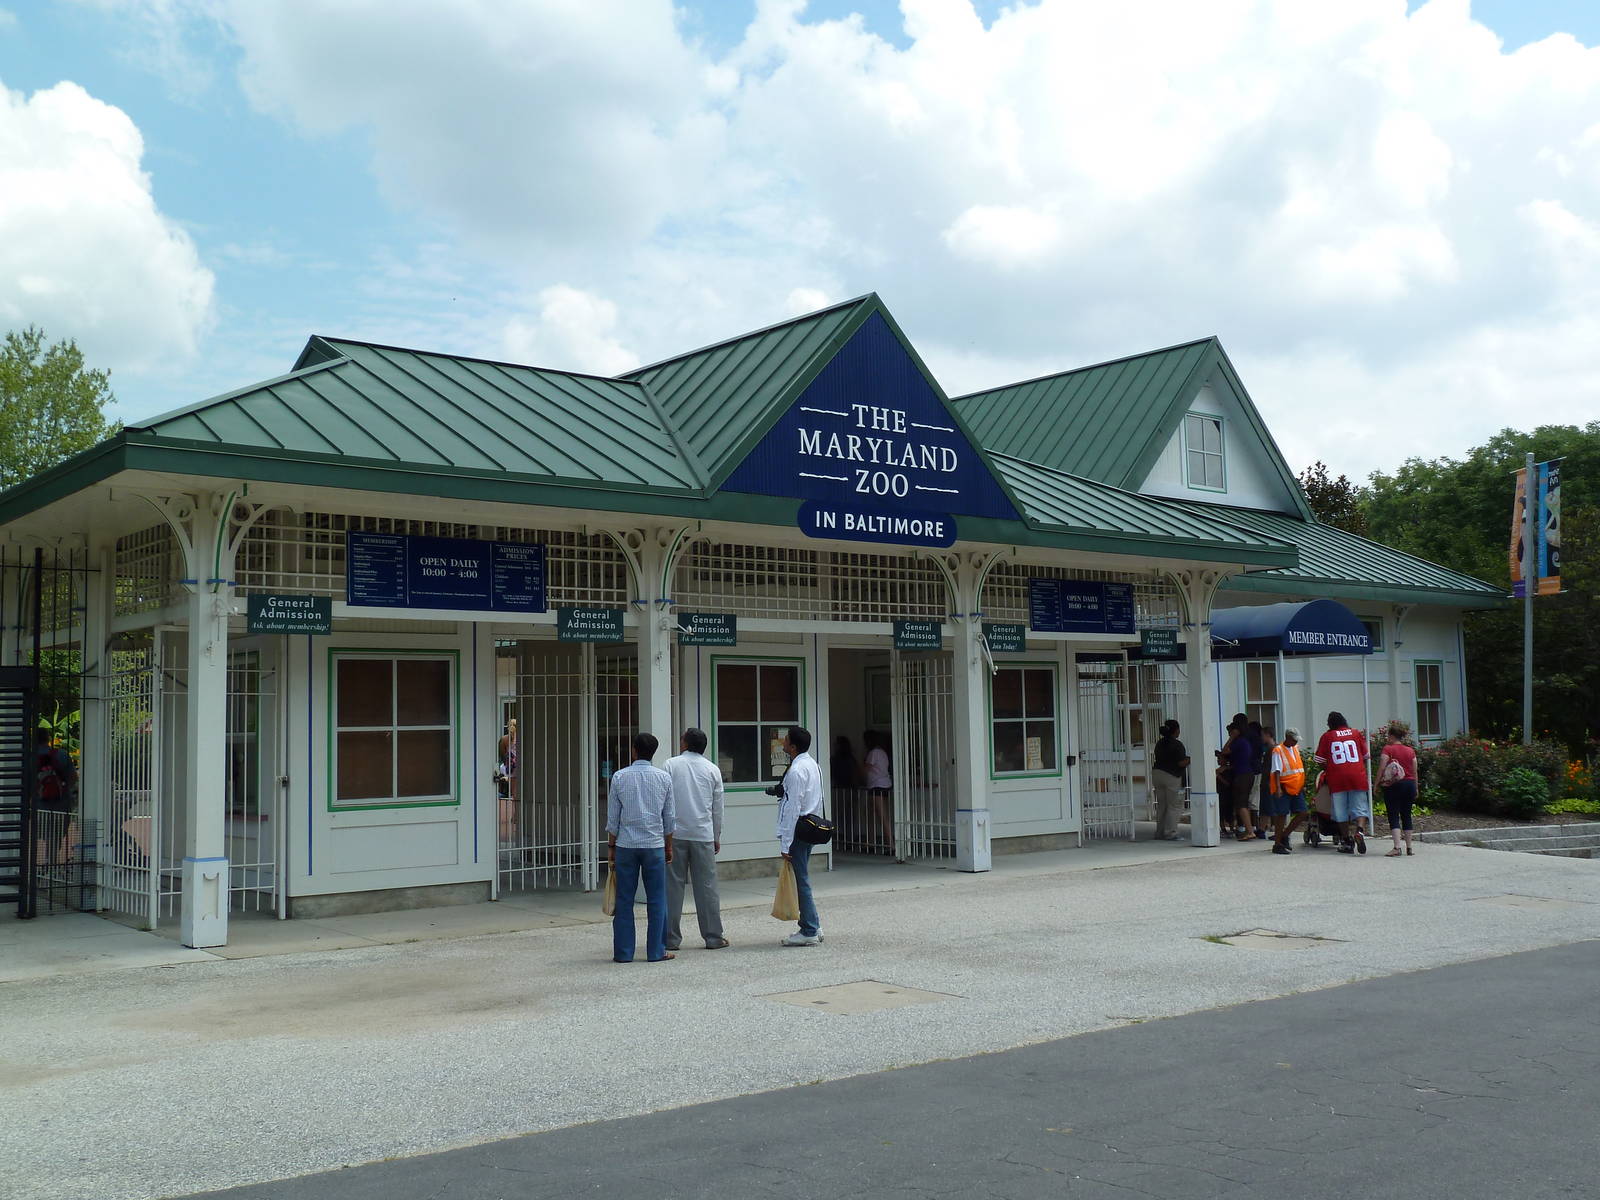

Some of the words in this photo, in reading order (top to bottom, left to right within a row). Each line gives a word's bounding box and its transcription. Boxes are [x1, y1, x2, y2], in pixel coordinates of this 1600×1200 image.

[852, 404, 907, 434] THE
[798, 428, 958, 472] MARYLAND
[855, 469, 909, 498] ZOO
[816, 510, 836, 529] IN
[845, 513, 944, 538] BALTIMORE
[420, 557, 447, 566] OPEN
[450, 559, 480, 568] DAILY
[422, 568, 446, 576] 10:00
[458, 570, 478, 578] 4:00
[268, 597, 314, 608] General
[260, 608, 321, 619] Admission
[573, 609, 610, 620] General
[567, 619, 616, 630] Admission
[692, 615, 724, 624] General
[905, 623, 932, 631] General
[992, 625, 1017, 633] General
[589, 632, 623, 640] membership!
[900, 630, 936, 640] Admission
[988, 633, 1021, 641] Admission
[1289, 631, 1325, 645] MEMBER
[1327, 633, 1368, 647] ENTRANCE
[1336, 729, 1352, 737] RICE
[1331, 740, 1359, 764] 80
